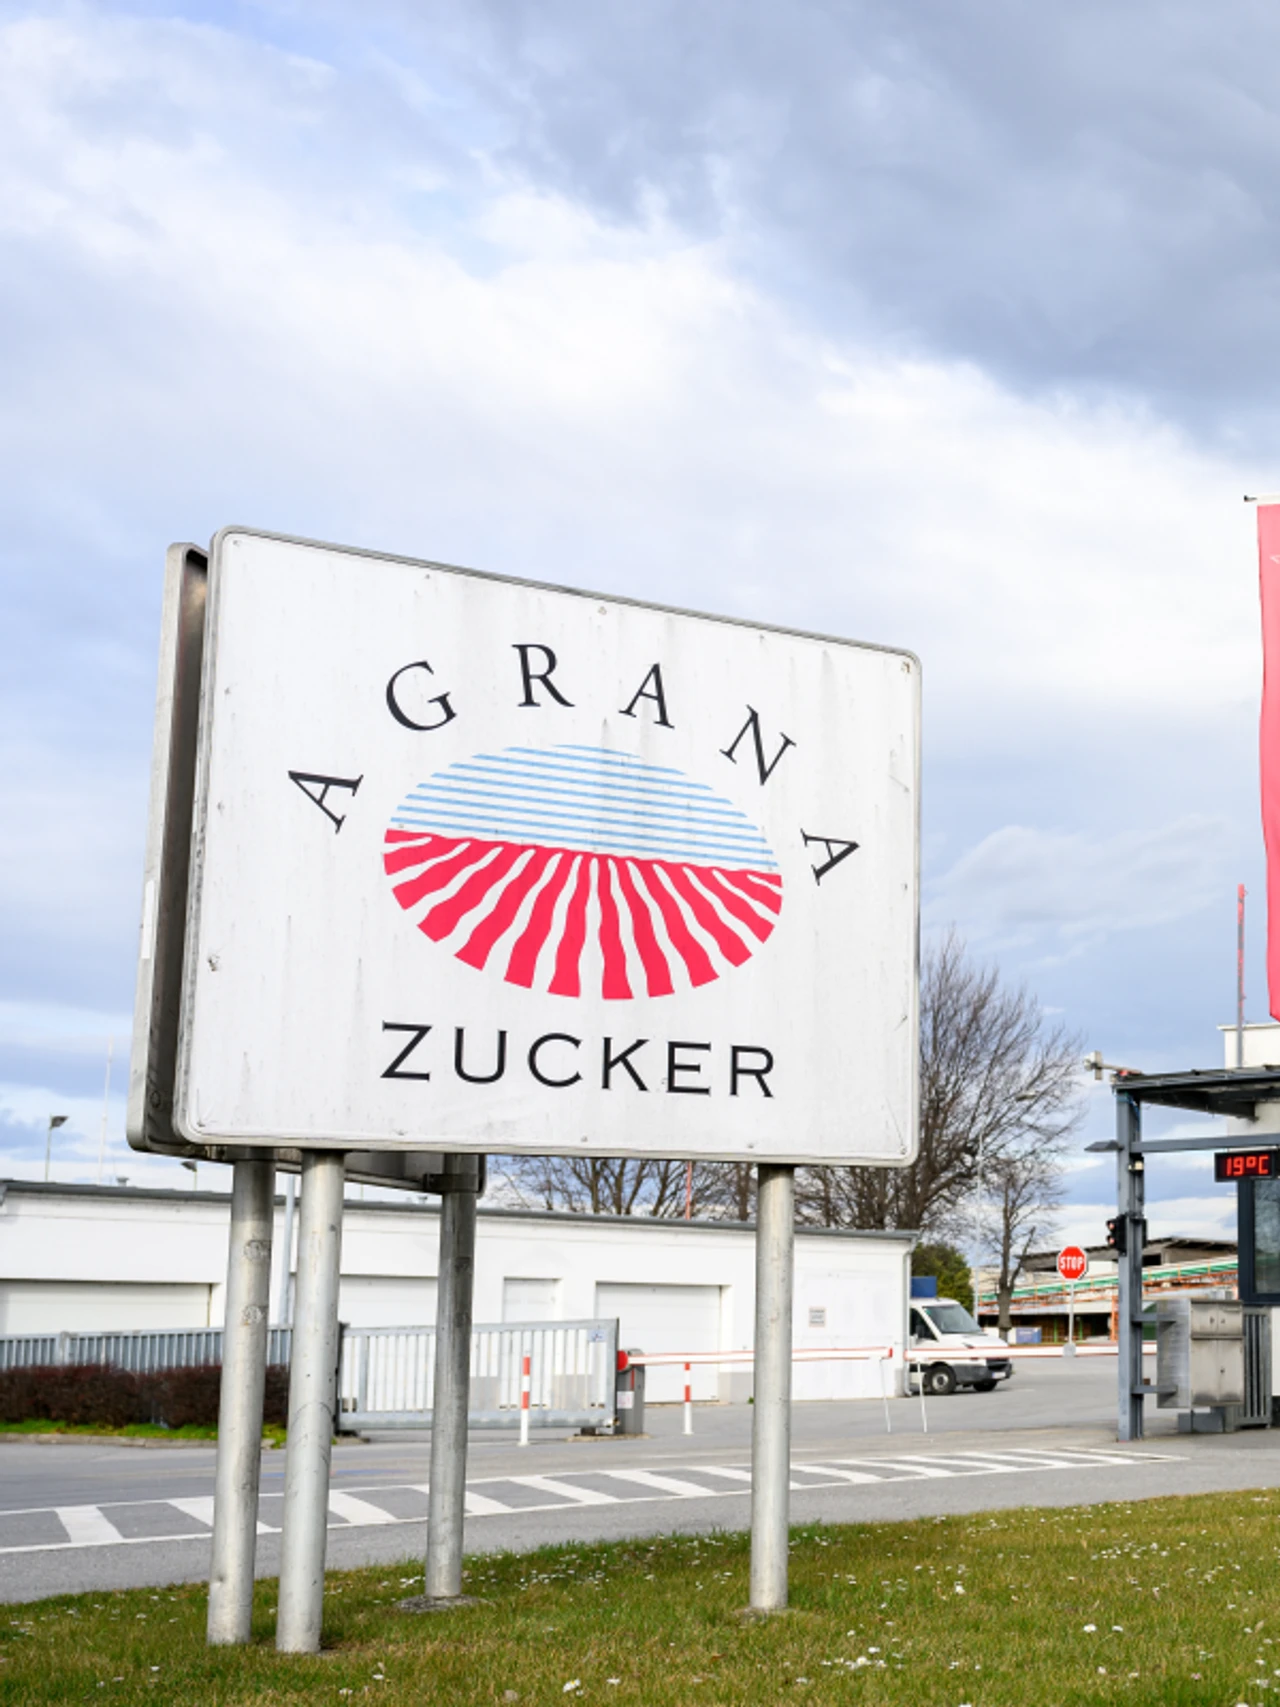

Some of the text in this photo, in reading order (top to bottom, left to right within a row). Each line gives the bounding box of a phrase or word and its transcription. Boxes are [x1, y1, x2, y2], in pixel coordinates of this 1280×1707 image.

[287, 643, 861, 886] AGRANA
[380, 1020, 775, 1099] ZUCKER
[1060, 1256, 1084, 1270] STOP
